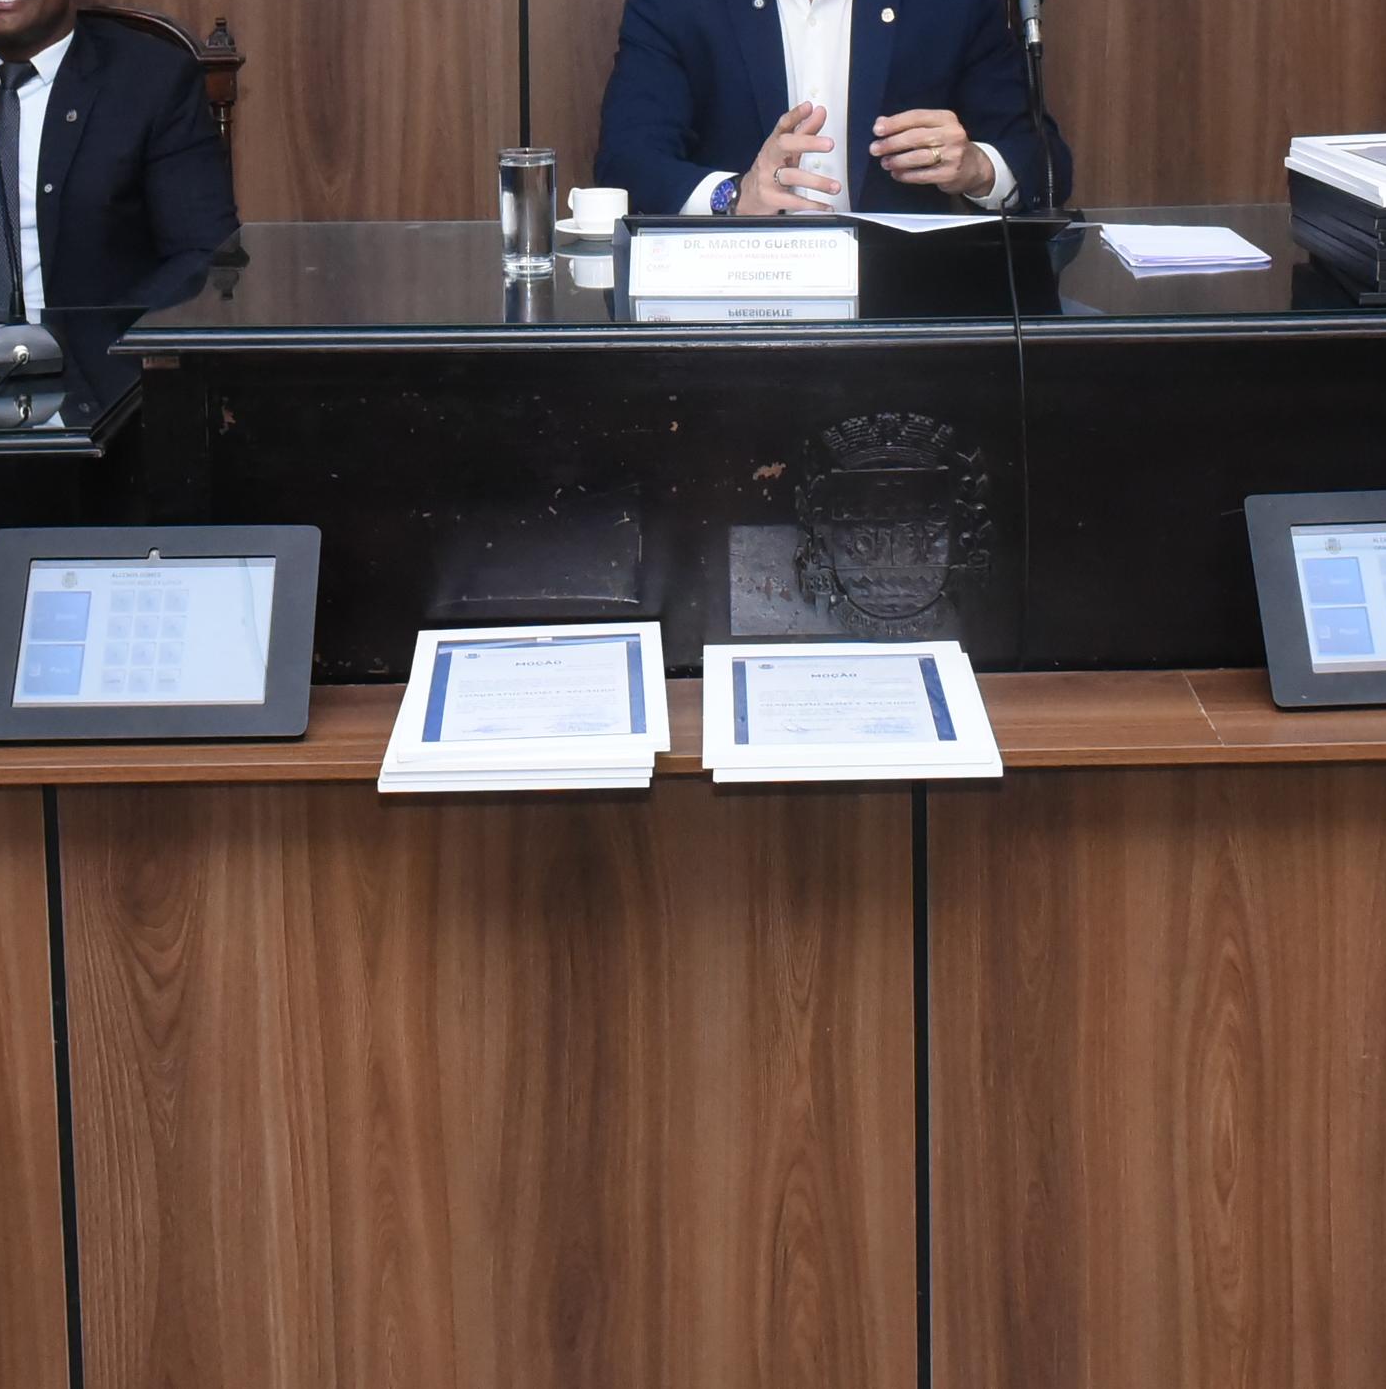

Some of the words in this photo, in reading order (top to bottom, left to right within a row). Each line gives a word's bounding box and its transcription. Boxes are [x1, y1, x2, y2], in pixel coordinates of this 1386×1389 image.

[683, 239, 705, 250] DR.
[708, 239, 761, 250] MARCIO
[764, 239, 838, 250] GUERREIRO
[727, 271, 793, 281] PRESIDENTE
